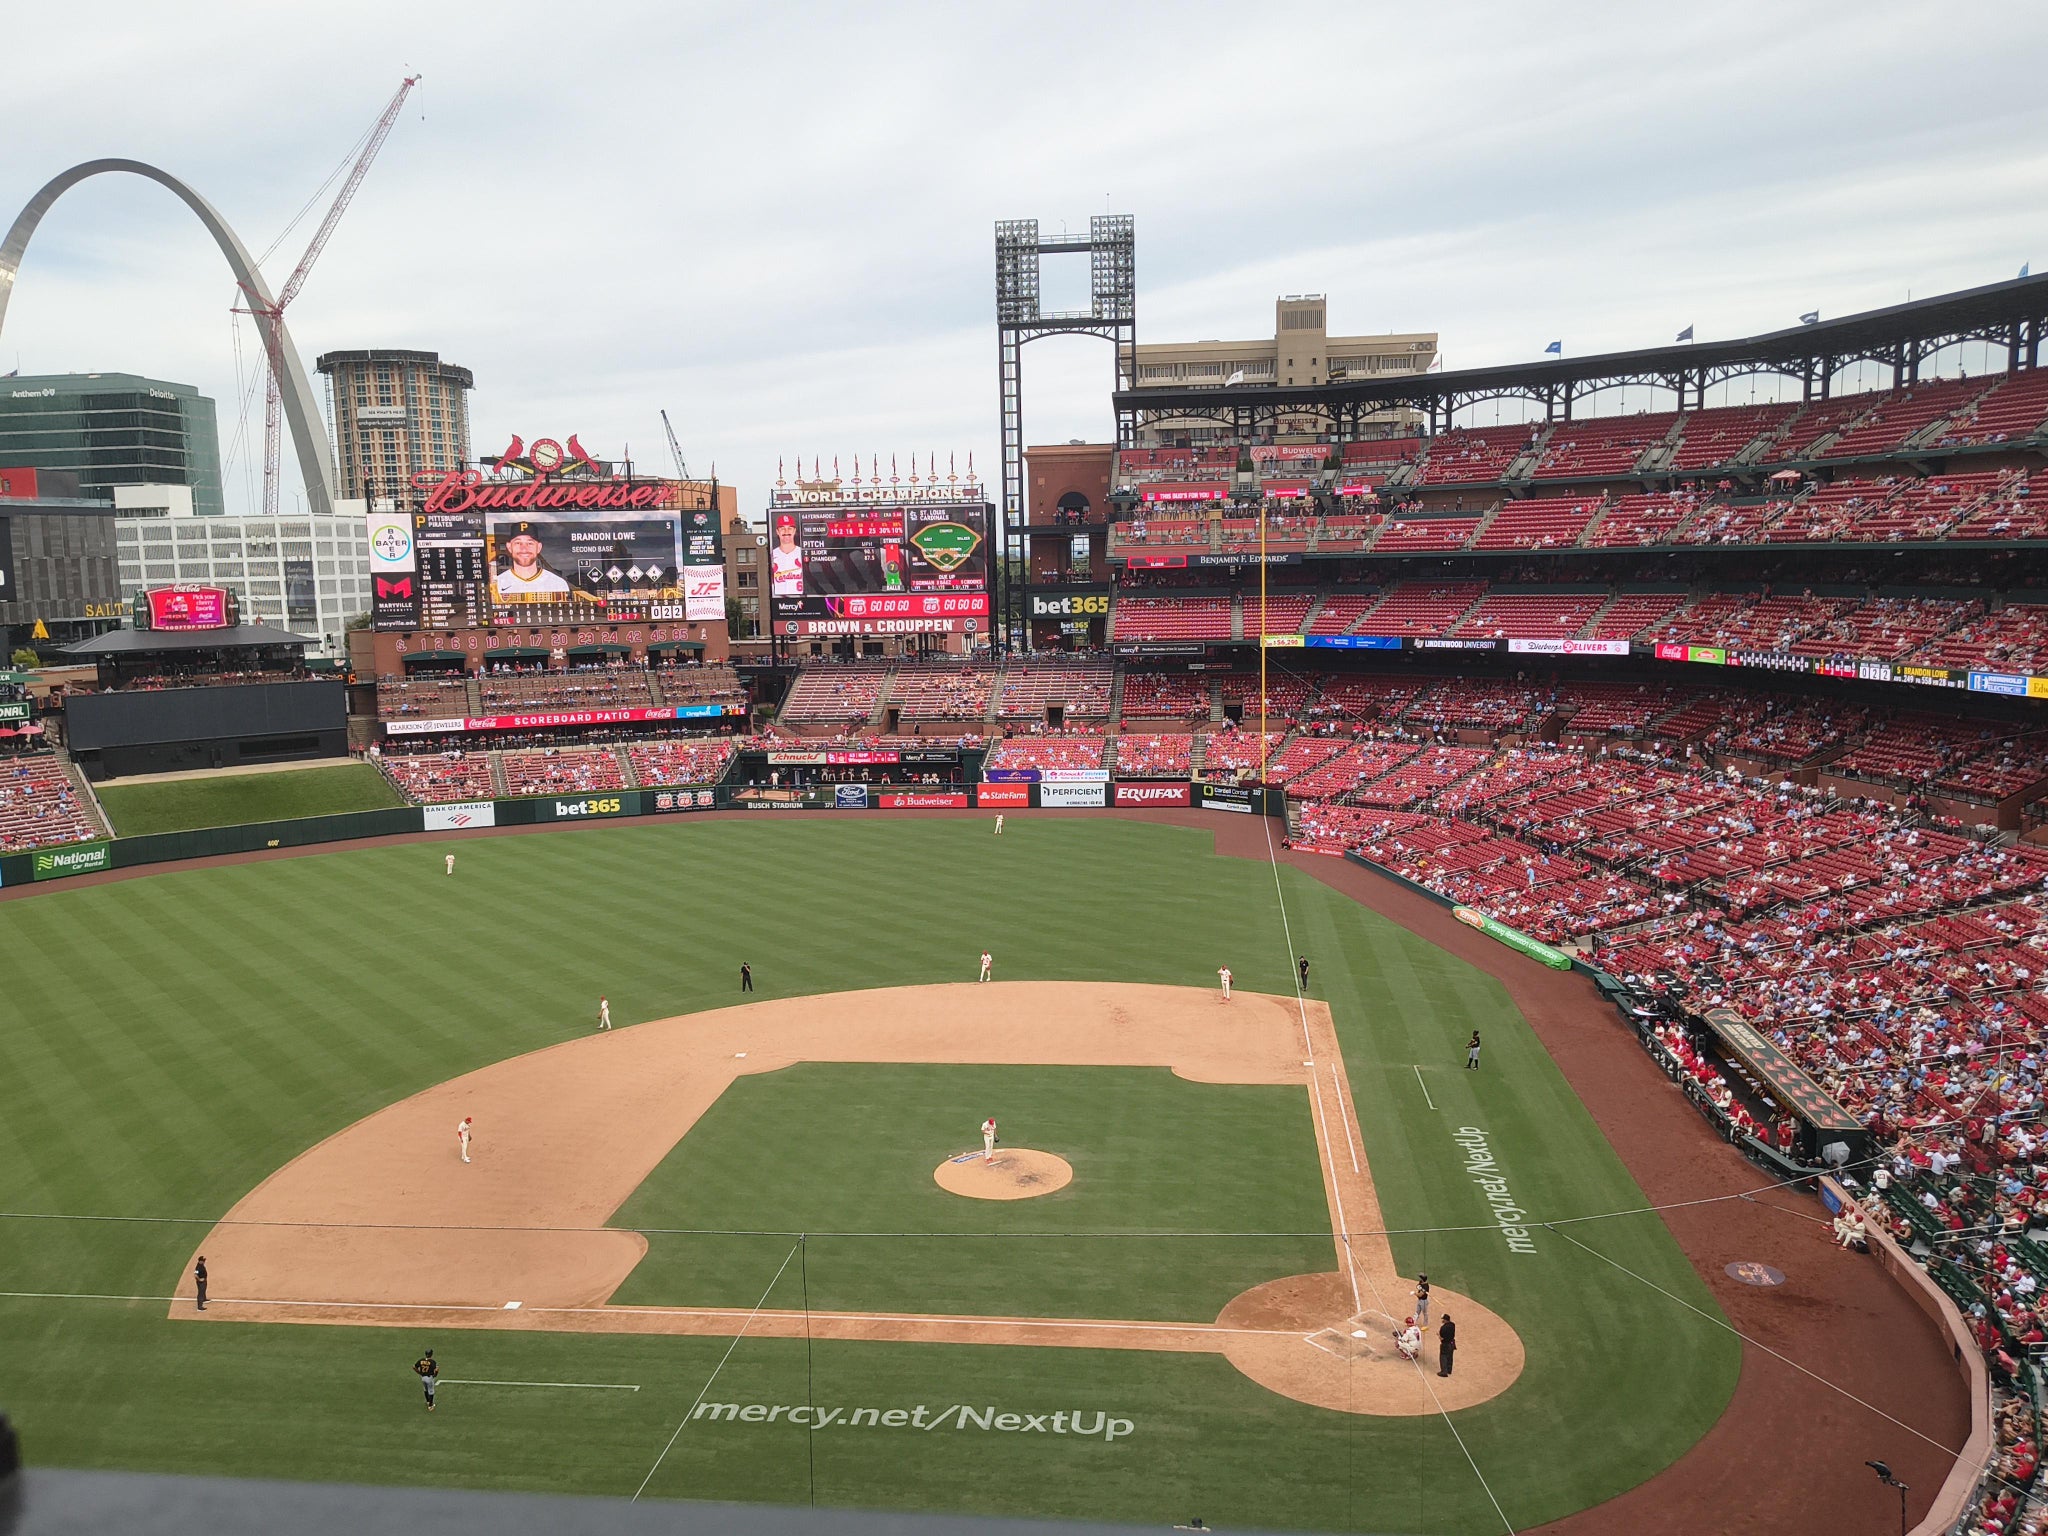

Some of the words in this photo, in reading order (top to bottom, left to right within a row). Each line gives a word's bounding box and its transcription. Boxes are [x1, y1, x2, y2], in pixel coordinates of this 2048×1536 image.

[12, 390, 41, 398] Anthem
[412, 469, 681, 512] Budweiser
[790, 490, 854, 503] WORLD
[858, 486, 963, 502] CHAMPIONS
[571, 532, 611, 541] BRANDON
[613, 532, 636, 540] LOWE
[1200, 556, 1239, 564] BENJAMIN
[1240, 555, 1248, 563] F.
[173, 584, 201, 593] Coca-Cola
[85, 602, 124, 617] SALT
[778, 603, 798, 611] Mercy
[870, 600, 882, 611] GO
[884, 600, 895, 611] GO
[898, 600, 910, 611] GO
[944, 599, 956, 610] GO
[958, 599, 969, 610] GO
[971, 599, 983, 610] GO
[1033, 596, 1109, 614] bet365
[654, 608, 659, 617] 0
[664, 608, 670, 617] 2
[675, 608, 680, 616] 2
[808, 620, 860, 633] BROWN
[864, 623, 873, 632] &
[877, 619, 950, 632] CROUPPEN
[1060, 621, 1089, 629] bet365
[507, 634, 522, 647] 14
[529, 634, 543, 647] 17
[551, 633, 568, 646] 20
[578, 632, 594, 645] 23
[601, 631, 618, 643] 24
[626, 630, 642, 643] 42
[650, 630, 666, 642] 45
[672, 628, 688, 641] 85
[435, 638, 444, 651] 2
[451, 637, 461, 650] 6
[468, 636, 478, 649] 9
[486, 635, 500, 649] 10
[1425, 639, 1463, 649] LINDENWOOD
[1464, 641, 1496, 649] UNIVERSITY
[1873, 669, 1877, 679] 2
[1883, 670, 1888, 679] 2
[1904, 666, 1931, 677] BRANDON
[1932, 669, 1948, 679] LOWE
[514, 713, 592, 726] SCOREBOARD
[597, 712, 630, 721] PATIO
[645, 708, 672, 719] Coca-Cola
[391, 723, 423, 731] CLARKSON
[469, 718, 498, 729] Coca-Cola
[842, 786, 861, 795] Ford
[1117, 788, 1183, 802] EQUIFAX
[555, 798, 621, 816] bet365
[907, 797, 954, 806] Budweiser
[53, 848, 104, 867] National
[85, 860, 104, 868] Rental
[1452, 1126, 1537, 1253] mercy.net/NextUp
[693, 1402, 1135, 1441] mercy.net/NextUp
